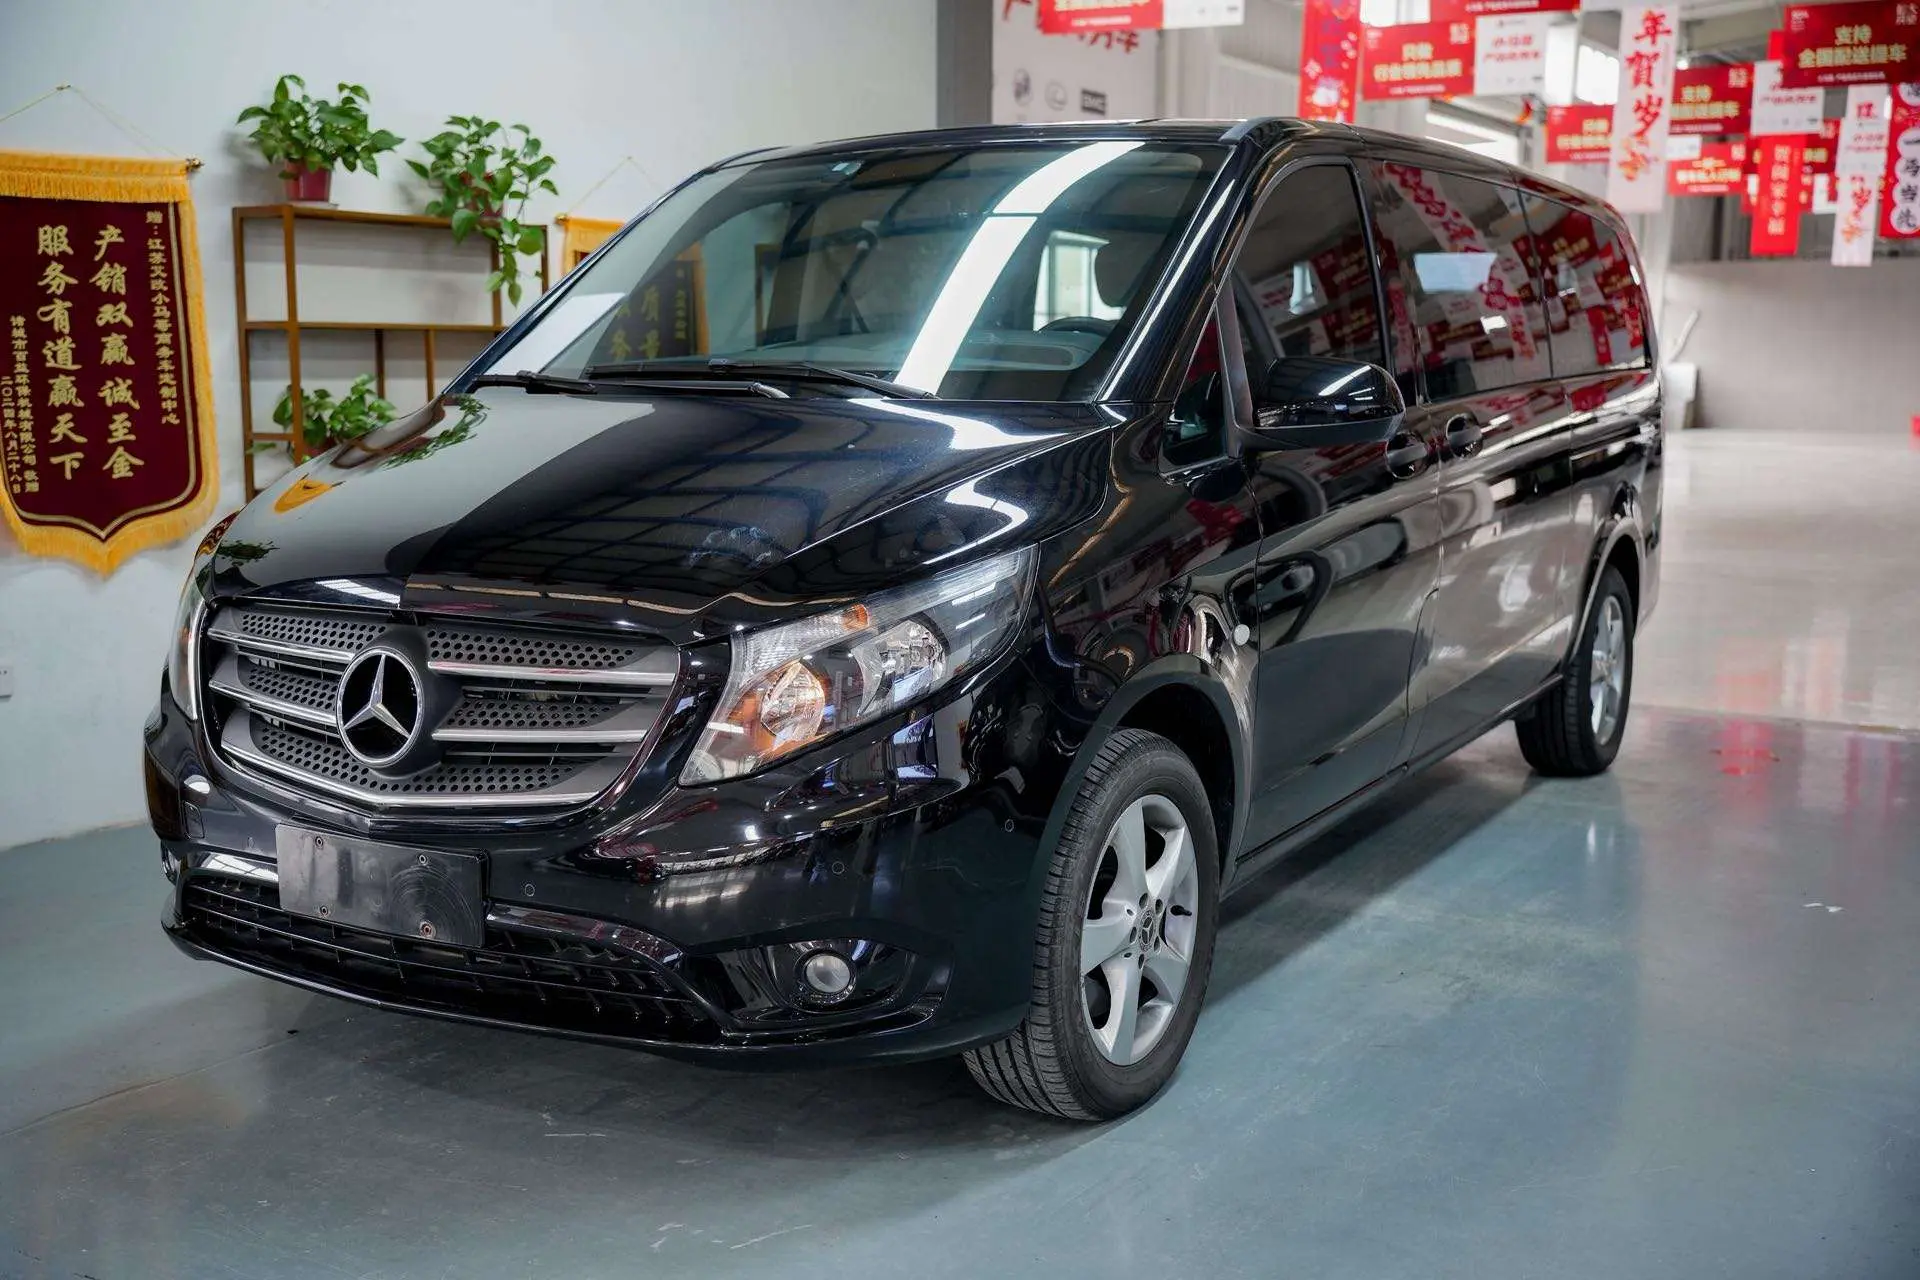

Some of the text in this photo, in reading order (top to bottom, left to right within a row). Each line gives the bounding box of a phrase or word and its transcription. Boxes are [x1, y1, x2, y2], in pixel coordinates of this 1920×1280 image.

[37, 225, 88, 480] 服务有道赢天下
[89, 224, 145, 480] 产销双赢诚至金
